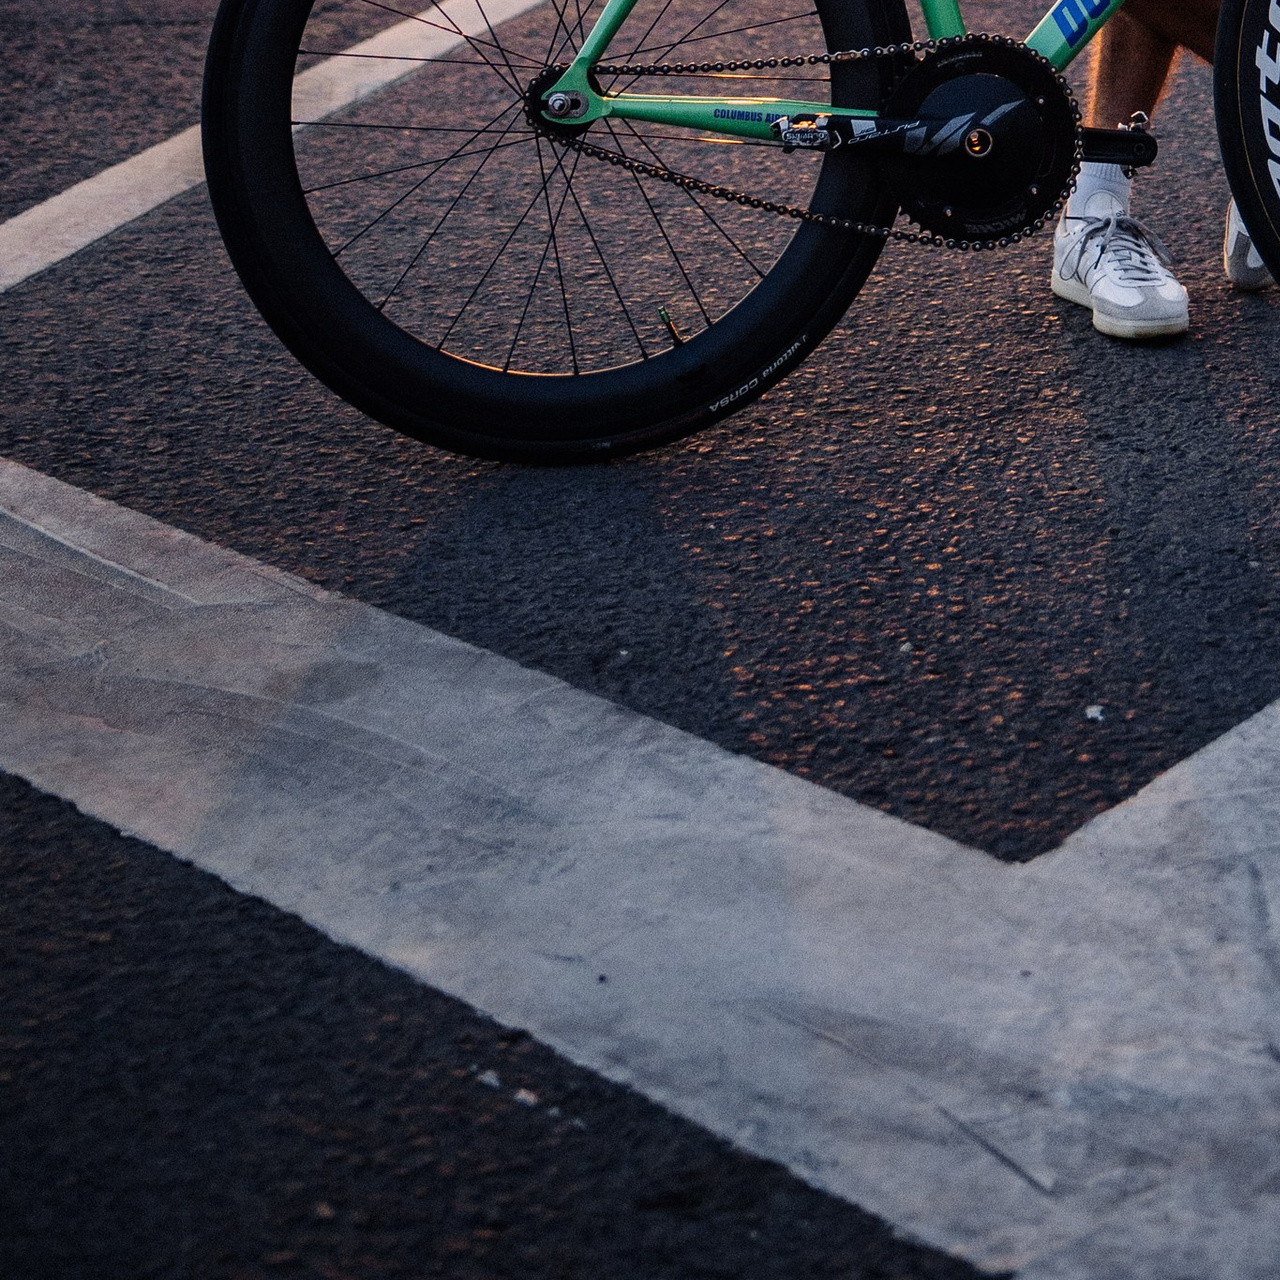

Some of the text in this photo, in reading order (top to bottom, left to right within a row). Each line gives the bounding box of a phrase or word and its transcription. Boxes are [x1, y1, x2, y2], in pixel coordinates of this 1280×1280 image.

[713, 108, 763, 122] COLUMBUS
[709, 342, 801, 412] vittoria CORSA
